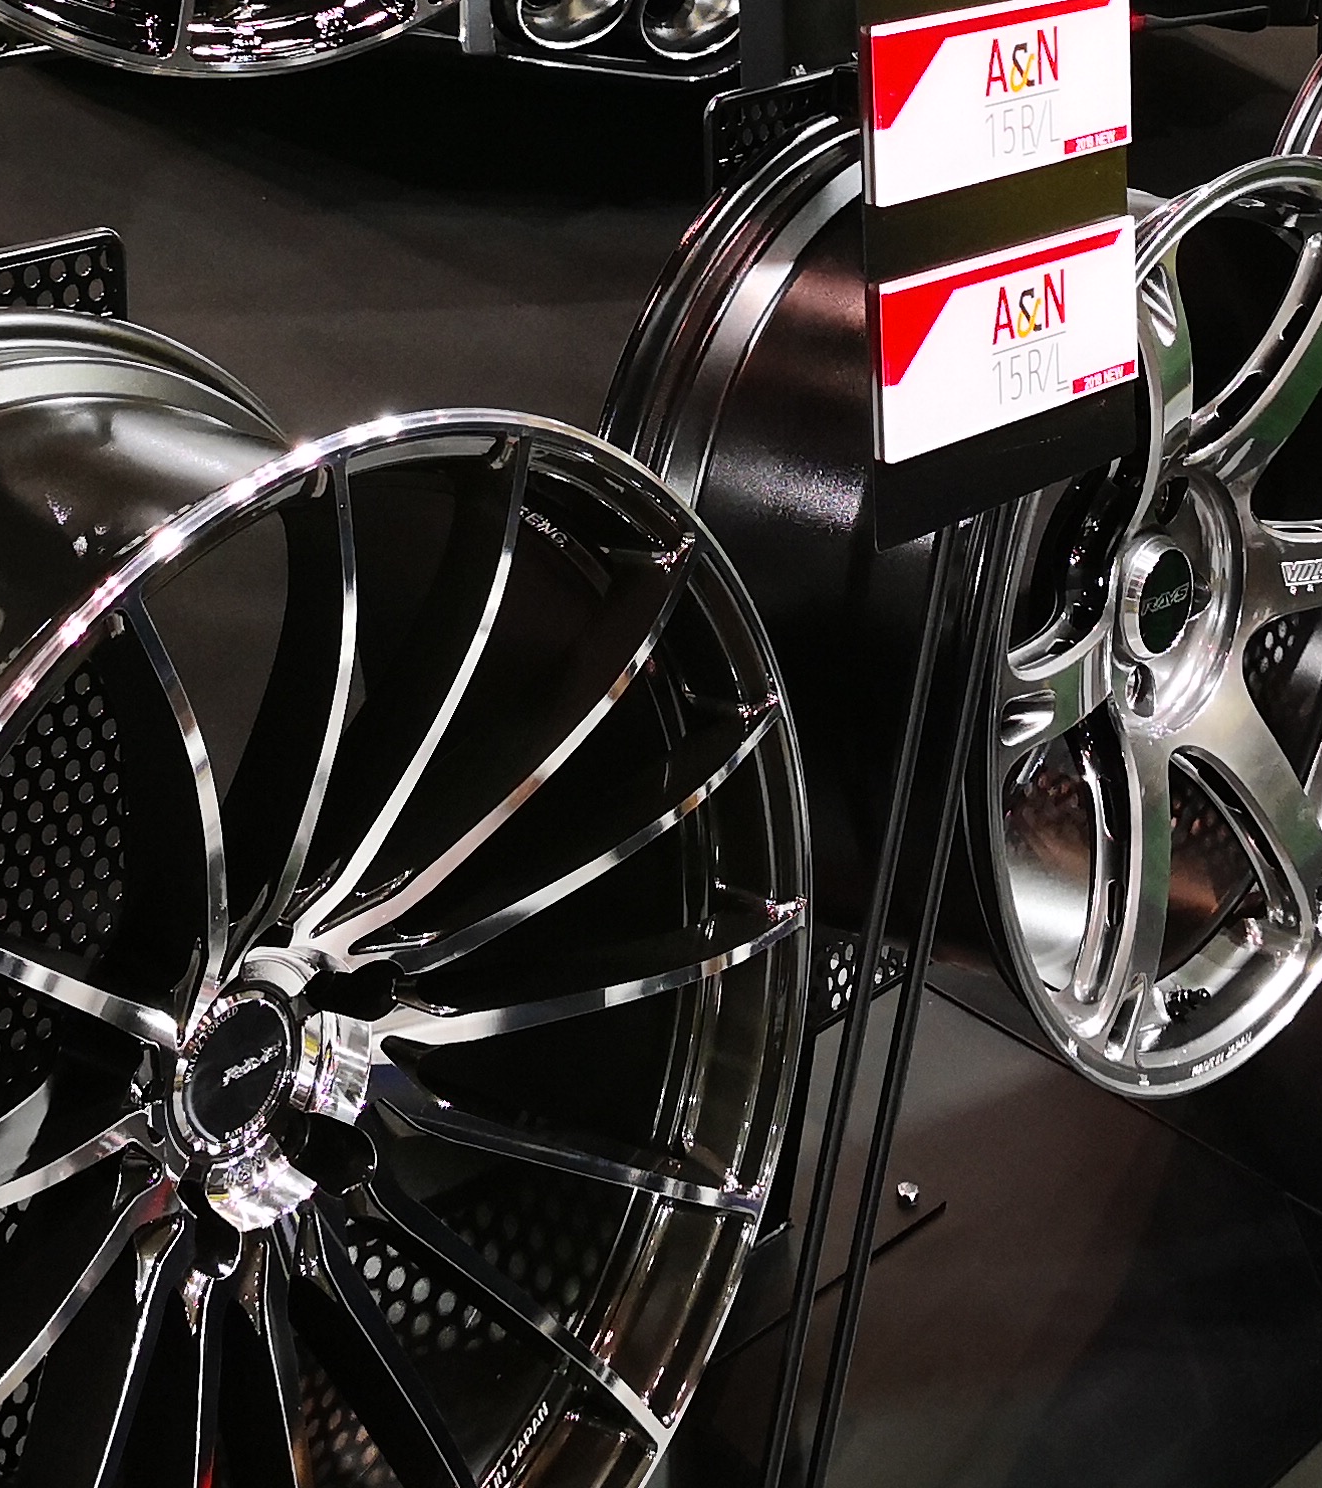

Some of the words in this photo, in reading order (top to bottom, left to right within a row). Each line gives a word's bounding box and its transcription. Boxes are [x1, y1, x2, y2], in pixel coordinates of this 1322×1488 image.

[985, 25, 1059, 97] A&N
[984, 99, 1061, 158] 15R/L
[1094, 129, 1117, 148] NEW
[992, 268, 1066, 346] A&N
[992, 342, 1070, 405] 15R/L
[1103, 364, 1125, 382] NEW
[1140, 581, 1190, 617] RAYS
[511, 1401, 549, 1468] JAPAN
